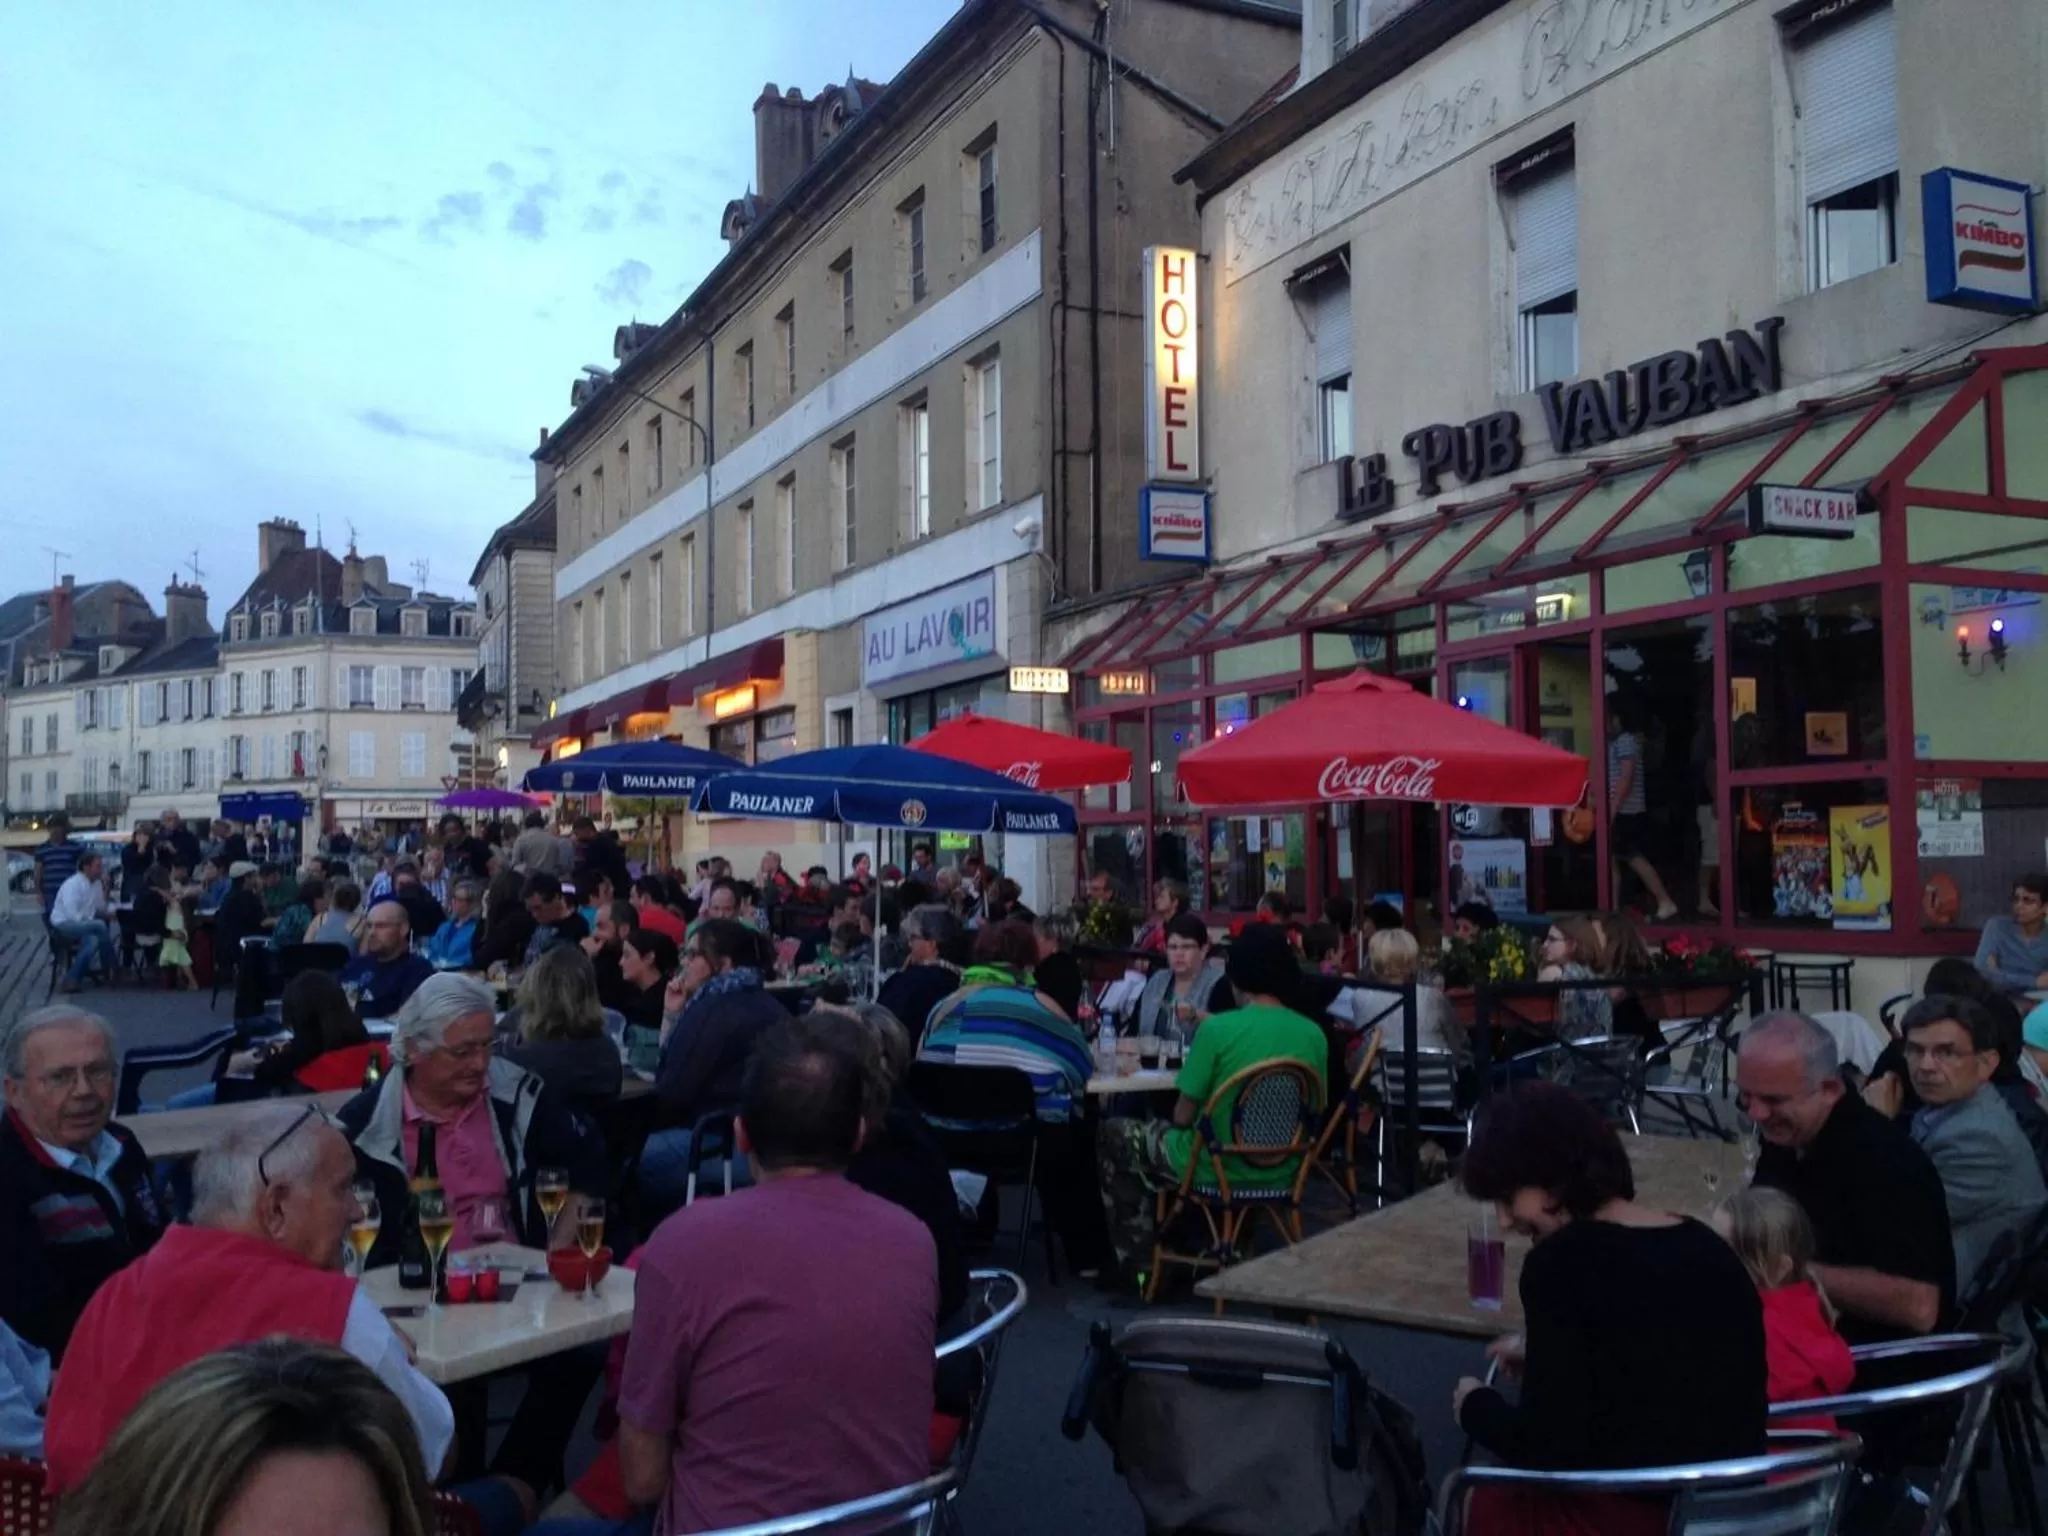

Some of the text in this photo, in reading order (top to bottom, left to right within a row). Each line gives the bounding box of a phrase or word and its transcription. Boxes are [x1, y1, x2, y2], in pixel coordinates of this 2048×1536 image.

[1956, 221, 2025, 250] KIMBO
[1161, 254, 1188, 471] HOTEL
[1335, 316, 1785, 520] LE PUB VAUBAN
[1774, 495, 1855, 520] SNACK BAR
[868, 596, 989, 666] AU LAVOIR
[623, 775, 695, 788] PAULANER
[1318, 755, 1442, 798] Coca-Cola
[729, 792, 814, 813] PAULANER
[1005, 811, 1060, 829] PAULANER
